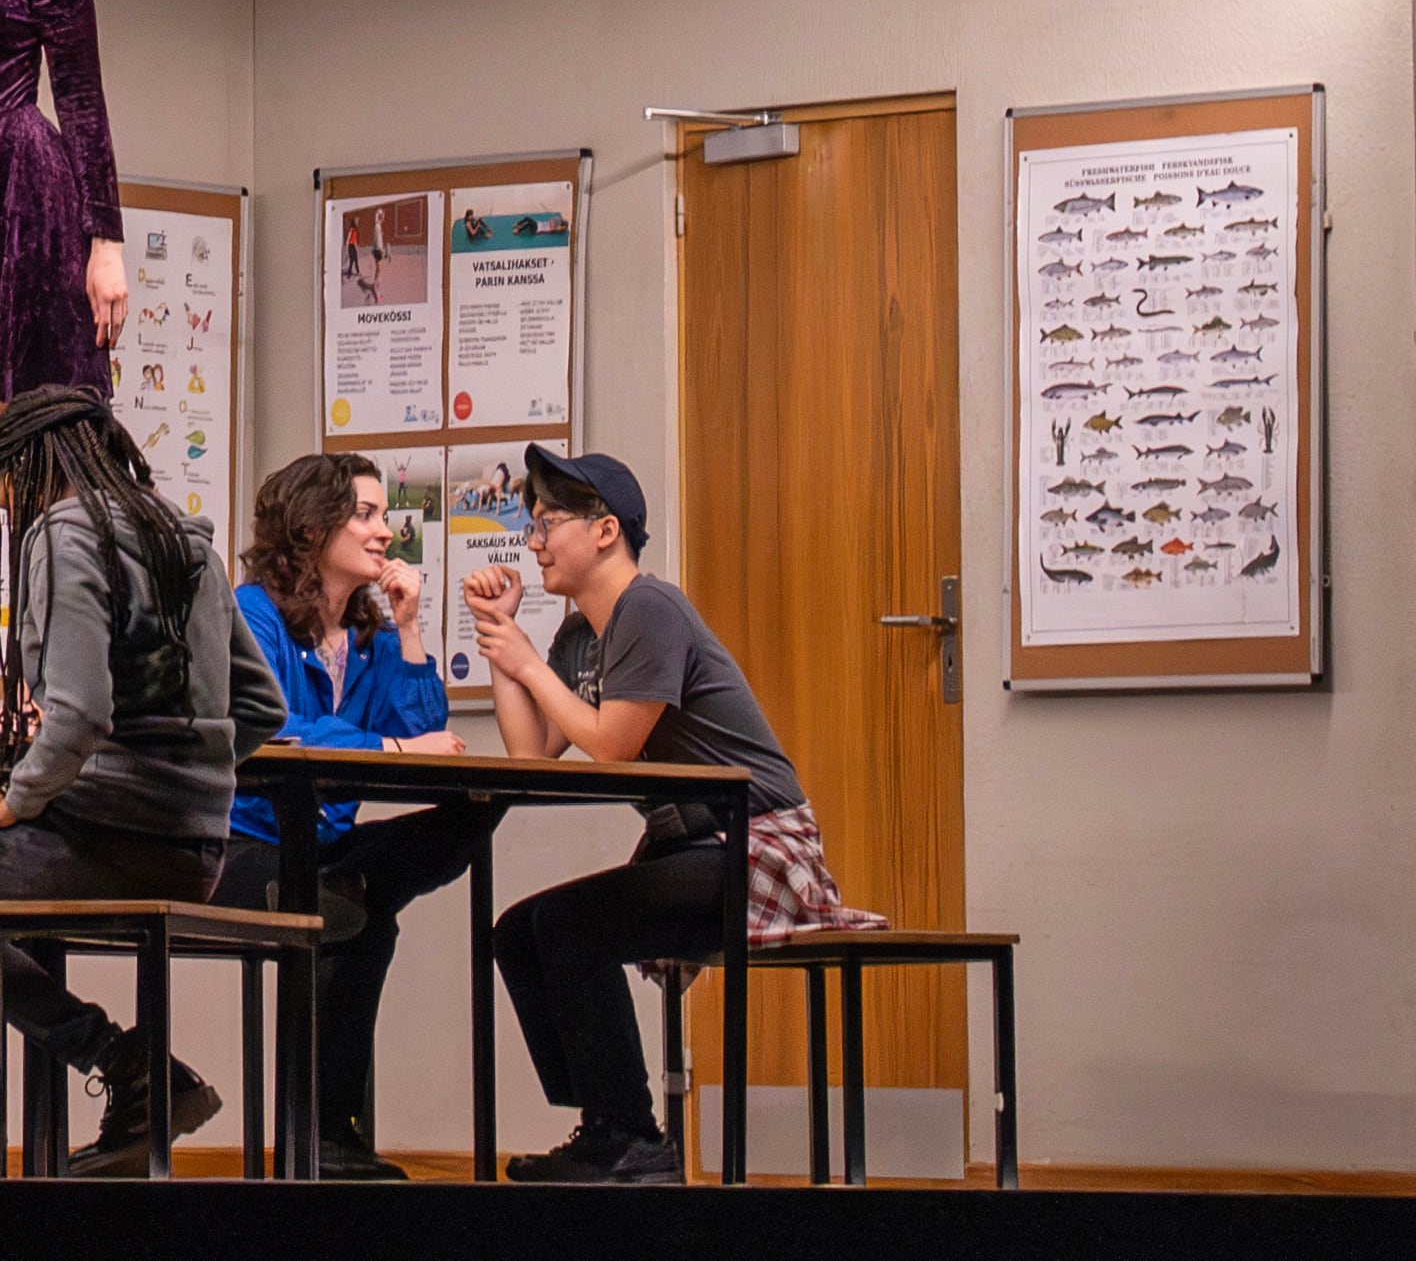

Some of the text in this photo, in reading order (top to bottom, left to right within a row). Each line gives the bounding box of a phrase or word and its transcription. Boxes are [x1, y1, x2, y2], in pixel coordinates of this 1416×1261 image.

[1223, 164, 1251, 175] DOUCE
[472, 257, 548, 272] VATSALIHAKSET
[475, 273, 545, 288] PARIN KANSSA
[487, 550, 520, 564] VÄLIIN
